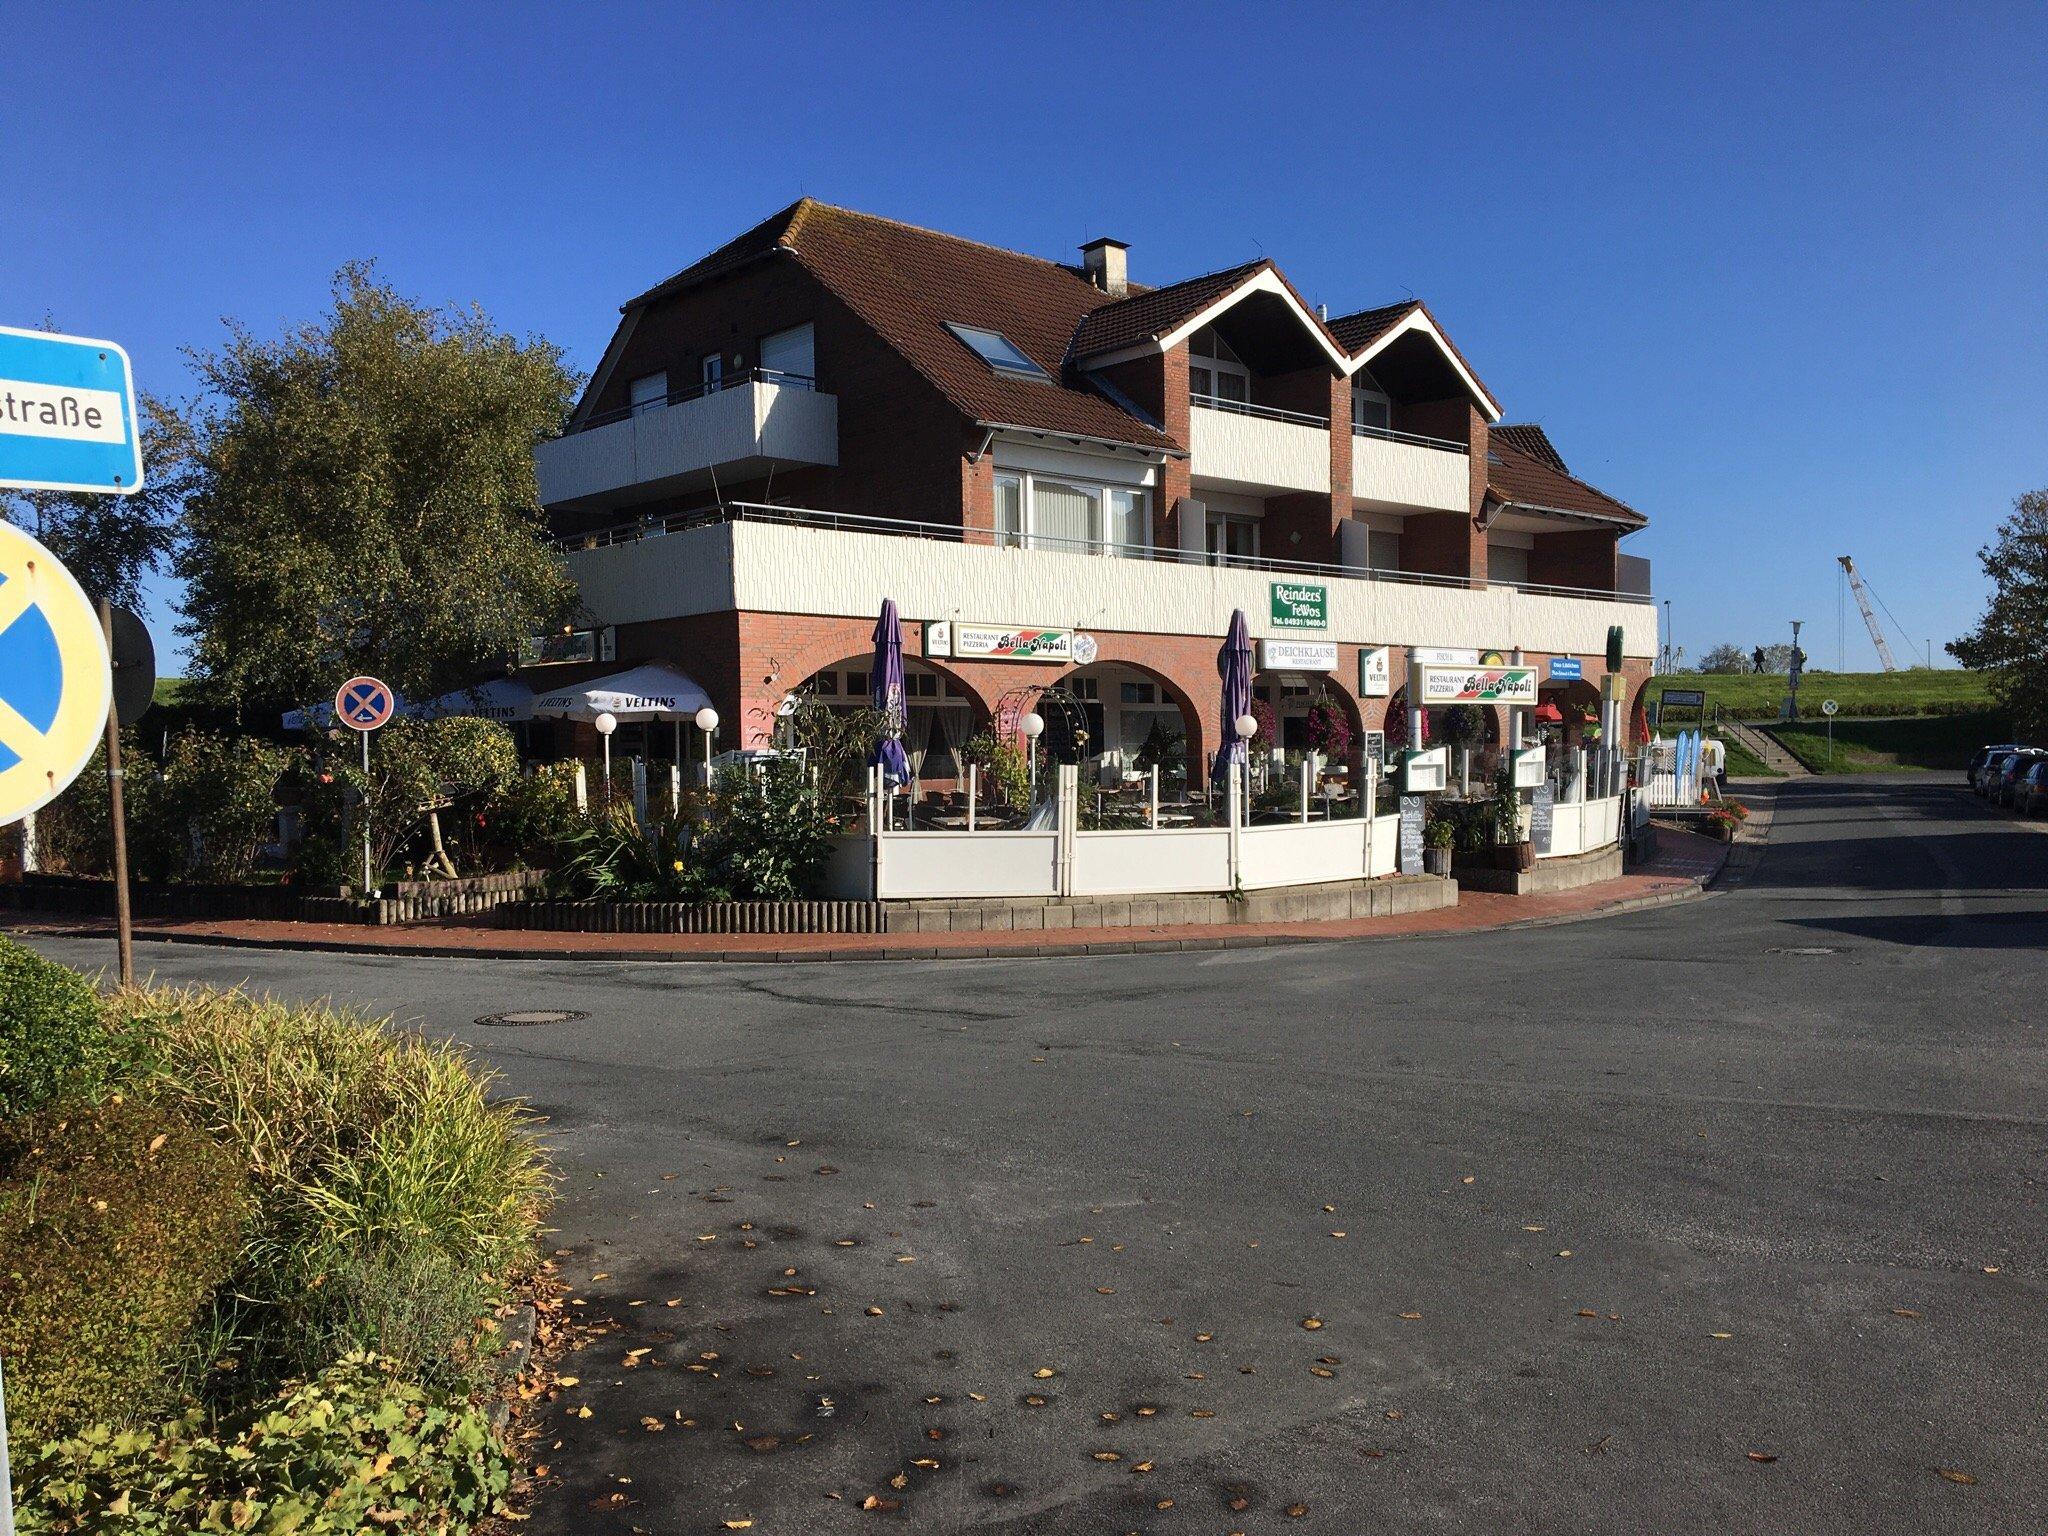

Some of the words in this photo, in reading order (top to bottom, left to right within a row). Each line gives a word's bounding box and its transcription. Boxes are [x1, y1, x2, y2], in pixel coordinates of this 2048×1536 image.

[998, 634, 1029, 649] Bella
[1030, 637, 1067, 653] Napoli
[1278, 646, 1335, 658] DEICHKLAUSE
[1464, 674, 1496, 692] Bella
[1496, 678, 1531, 695] Napoli
[625, 697, 676, 708] VELTINS
